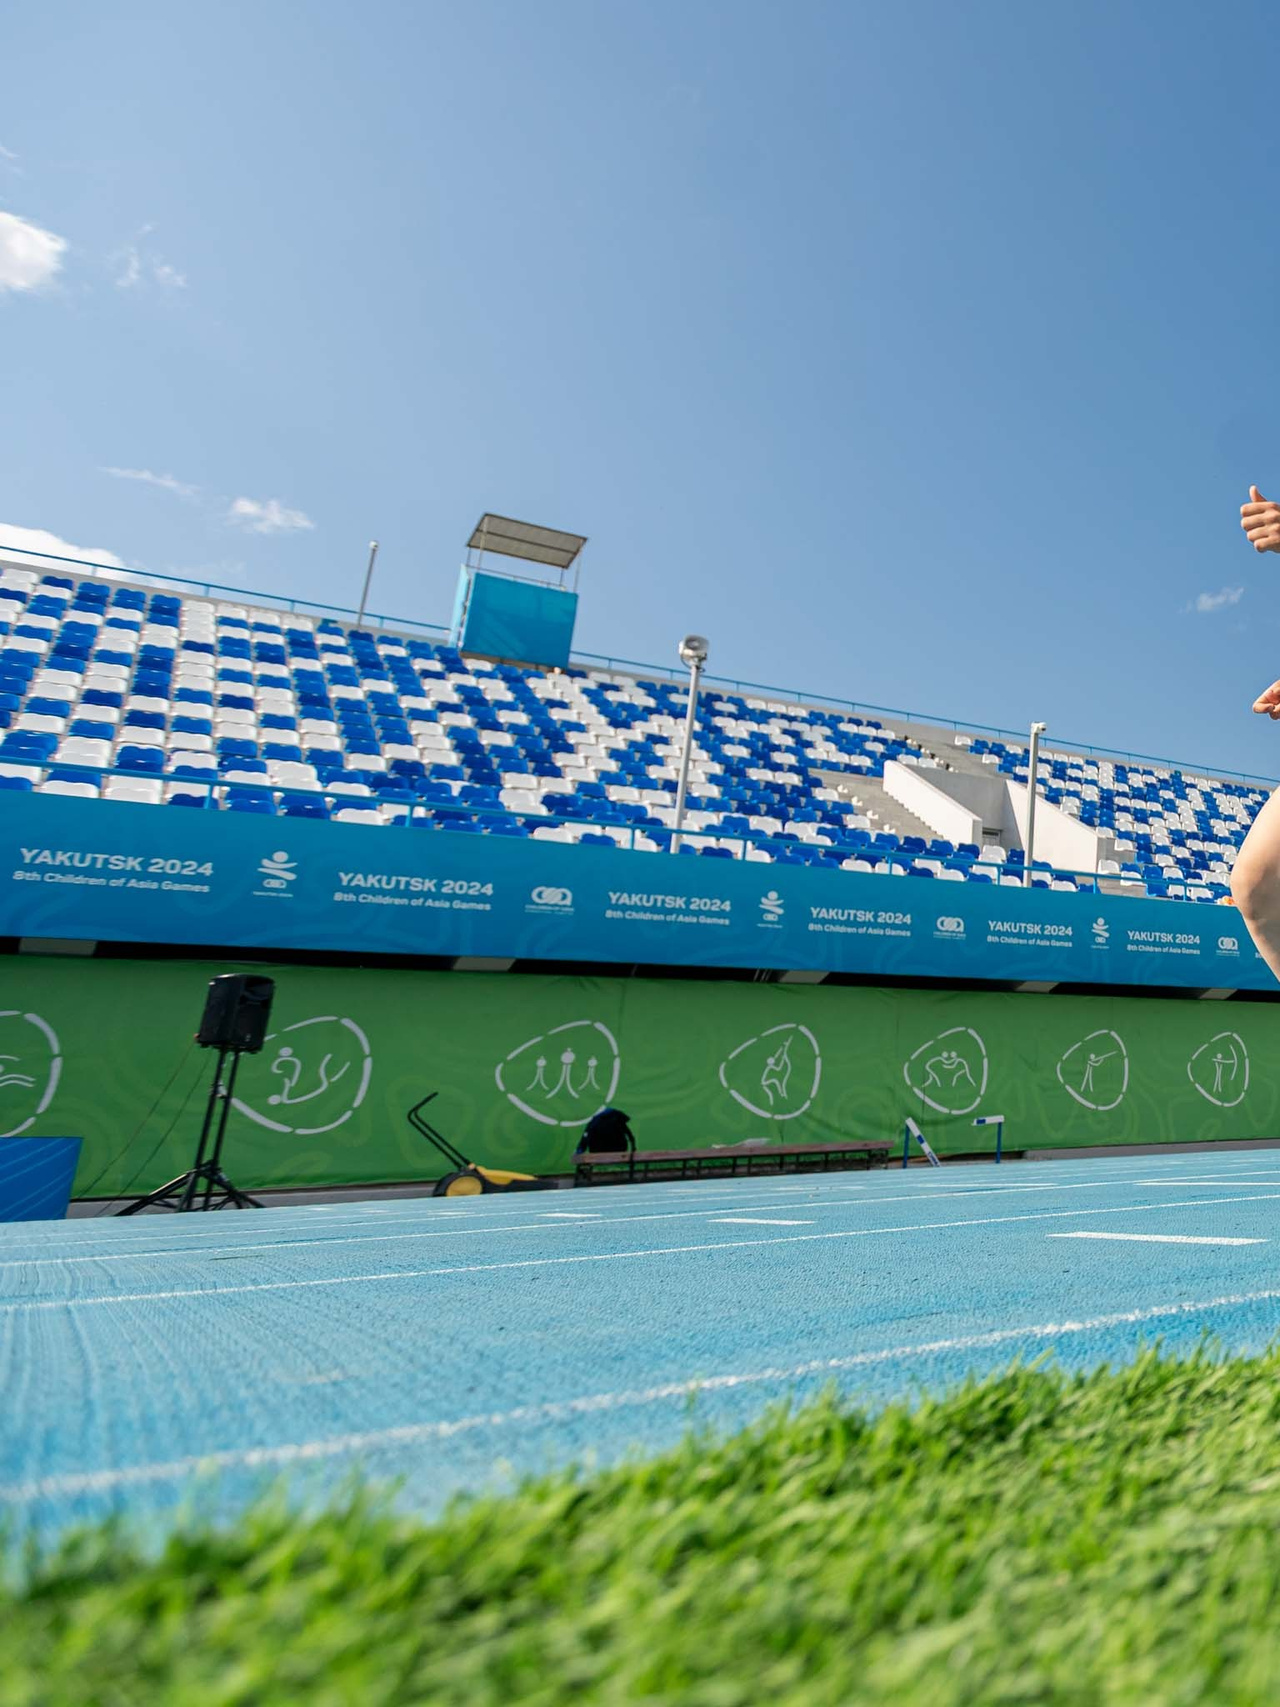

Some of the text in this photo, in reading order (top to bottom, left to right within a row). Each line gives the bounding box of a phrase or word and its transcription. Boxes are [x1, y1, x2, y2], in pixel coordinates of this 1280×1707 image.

[20, 847, 214, 877] YAKUTSK 2024
[13, 870, 210, 893] 8th Children of Asia Games
[338, 872, 494, 896] YAKUTSK 2024
[333, 892, 491, 911] 8th Children of Asia Games
[608, 891, 731, 912] YAKUTSK 2024
[605, 909, 623, 919] 8th
[625, 910, 665, 921] Children
[676, 913, 697, 923] Asia
[698, 915, 730, 925] Games
[810, 907, 912, 925] YAKUTSK 2024
[808, 923, 823, 932] 8th
[824, 924, 857, 934] Children
[867, 927, 884, 936] Asia
[885, 928, 911, 937] Games
[988, 920, 1073, 936] YAKUTSK 2024
[1127, 930, 1200, 944] YAKUTSK 2024
